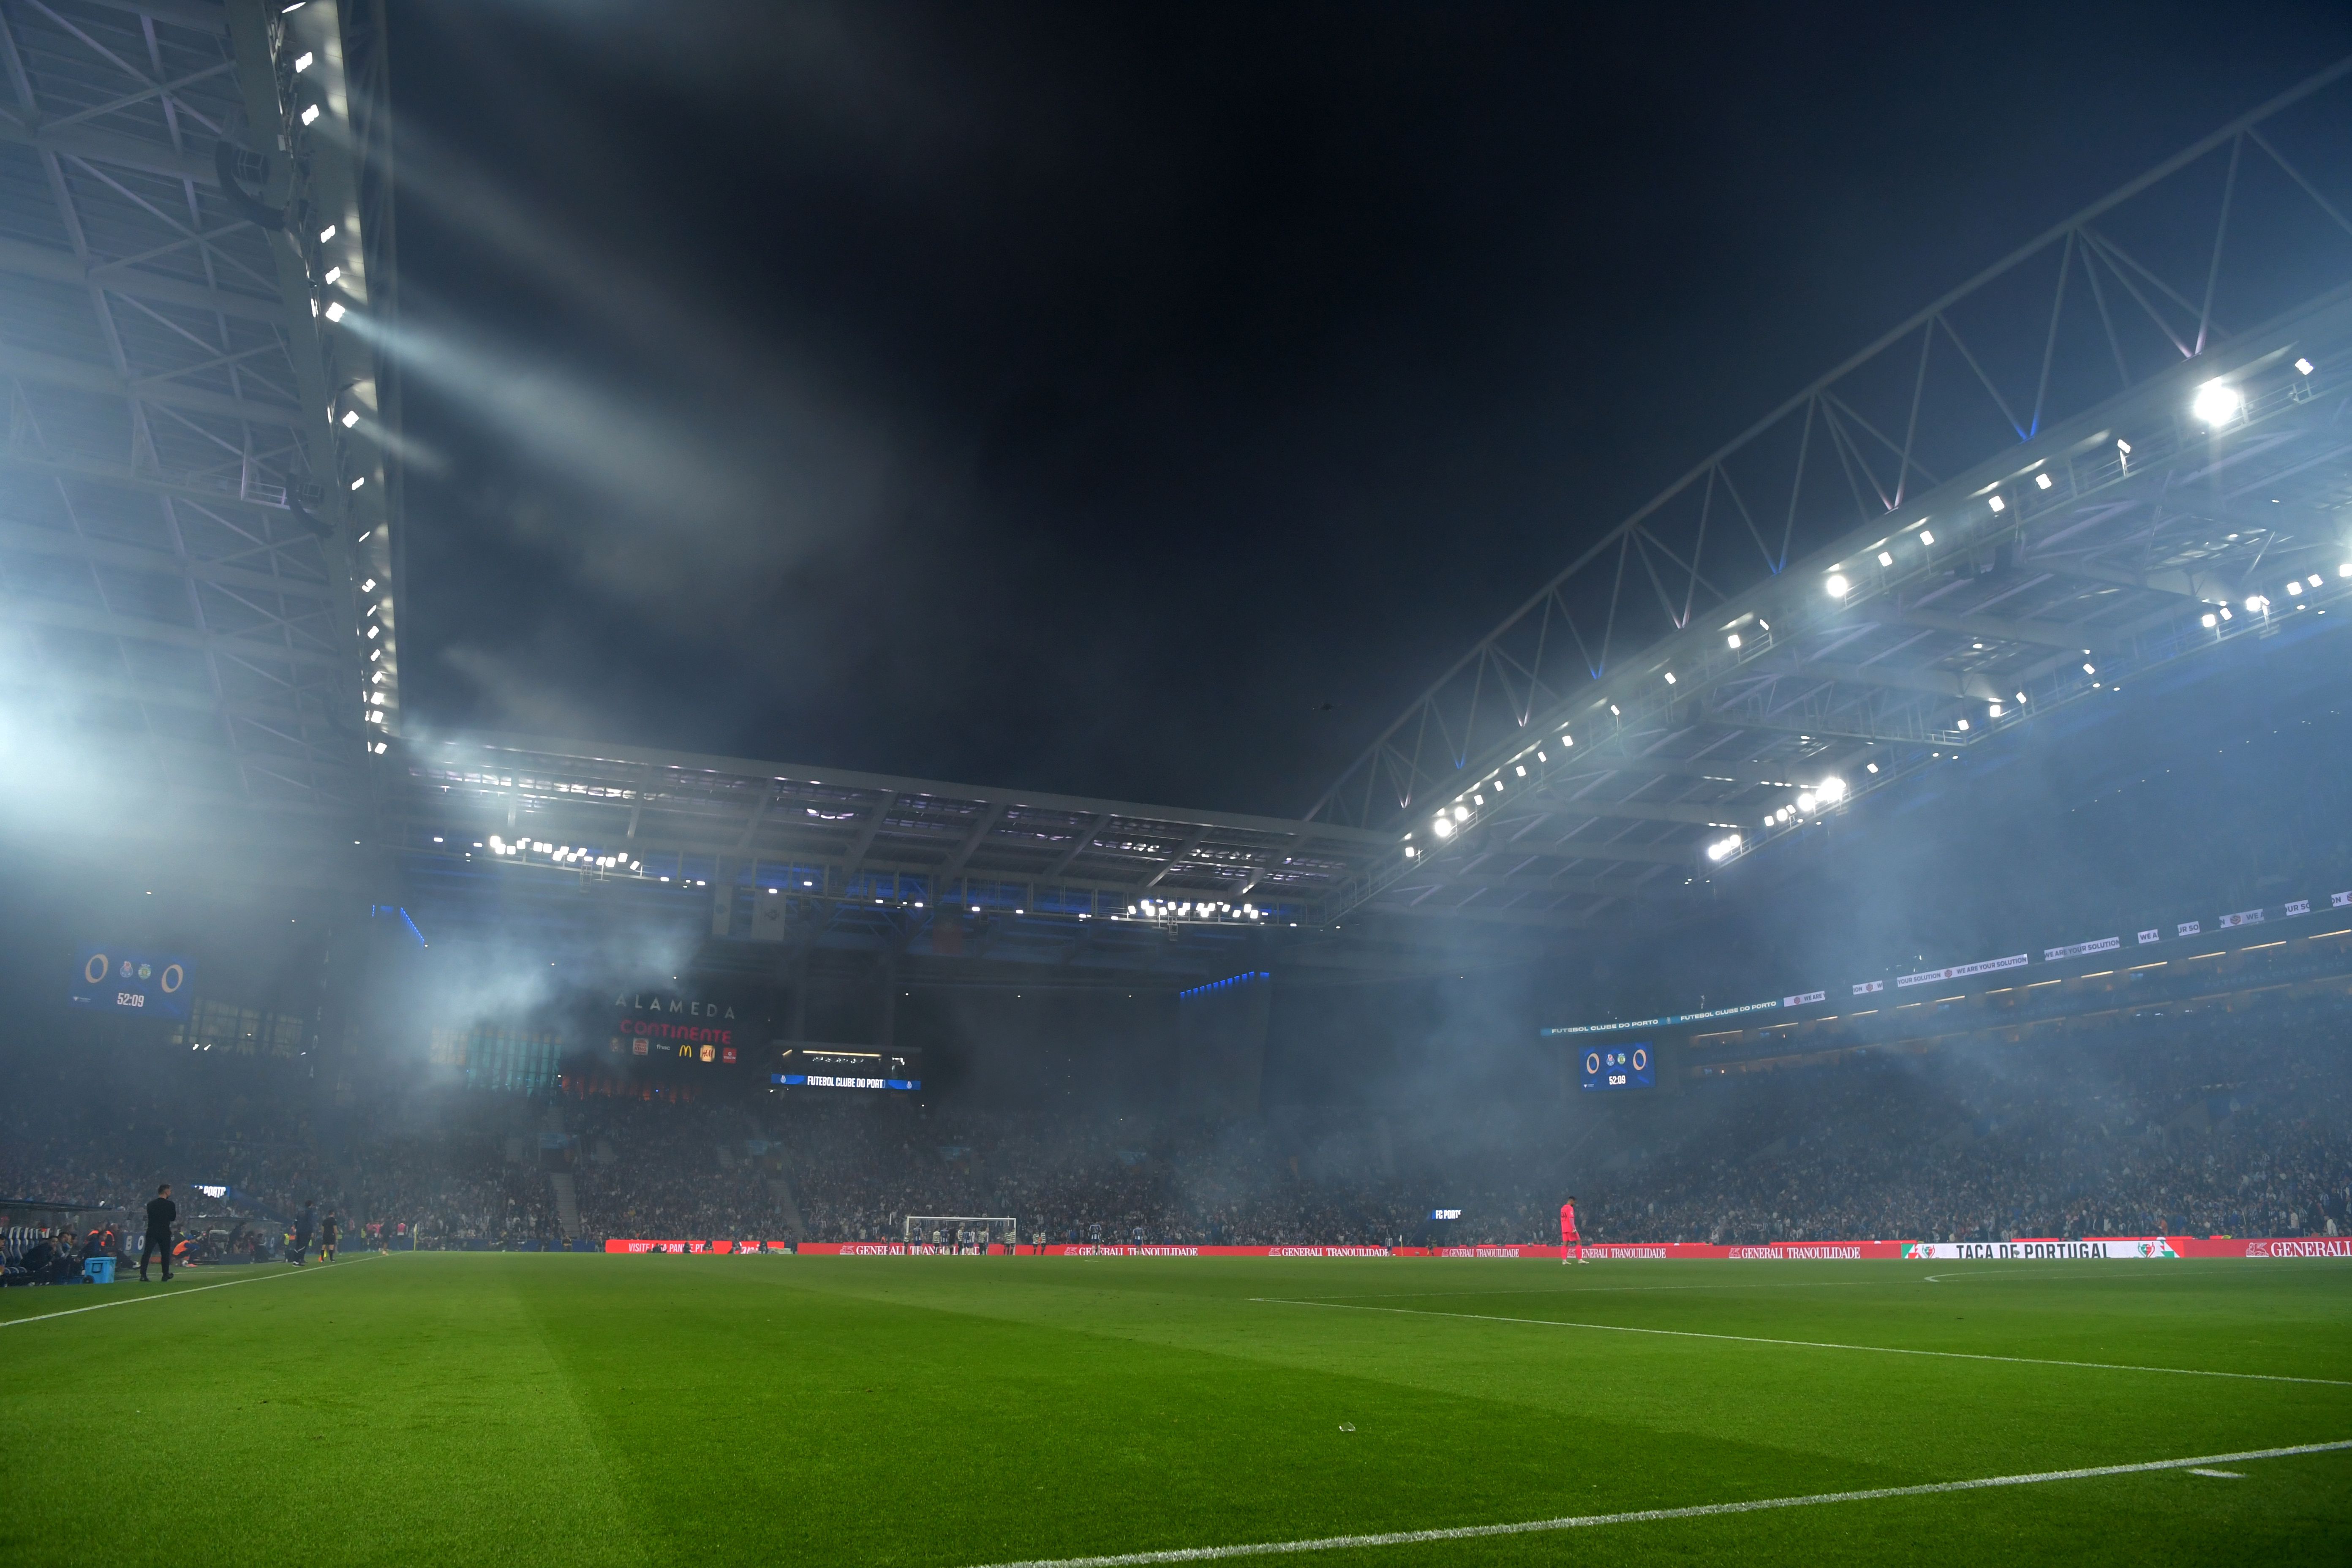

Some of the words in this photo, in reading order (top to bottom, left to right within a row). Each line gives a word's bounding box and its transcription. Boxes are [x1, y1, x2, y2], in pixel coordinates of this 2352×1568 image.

[2068, 945, 2086, 954] YOUR
[1996, 957, 2026, 967] SOLUTION
[85, 954, 109, 983] 0
[161, 964, 183, 993] 0
[1914, 972, 1941, 982] SOLUTION
[117, 992, 144, 1007] 52:09
[615, 993, 735, 1020] ALAMEDA
[1680, 1012, 1714, 1021] FUTEBOL
[1715, 1007, 1739, 1016] CLUBE
[1752, 1001, 1776, 1010] PORTO
[1586, 1053, 1600, 1074] 0
[1633, 1049, 1647, 1070] 0
[807, 1075, 835, 1086] FUTEBOL
[836, 1077, 856, 1087] CLUBE
[857, 1078, 866, 1088] DO
[1609, 1075, 1626, 1085] 52:09
[1435, 1210, 1443, 1219] FC
[1079, 1247, 1124, 1256] GEERALI
[1282, 1248, 1323, 1257] GENERALI
[1449, 1249, 1474, 1258] GENERALI
[1476, 1248, 1519, 1258] TRANQUILIDADE
[1581, 1249, 1608, 1258] ENERALI
[1611, 1248, 1666, 1259] TRANQUILIDADE
[1742, 1247, 1783, 1259] GENERALI
[1787, 1247, 1861, 1259] TRANQUILIDADE
[2025, 1243, 2111, 1258] PORTUGAL
[2271, 1241, 2352, 1258] GENERALI
